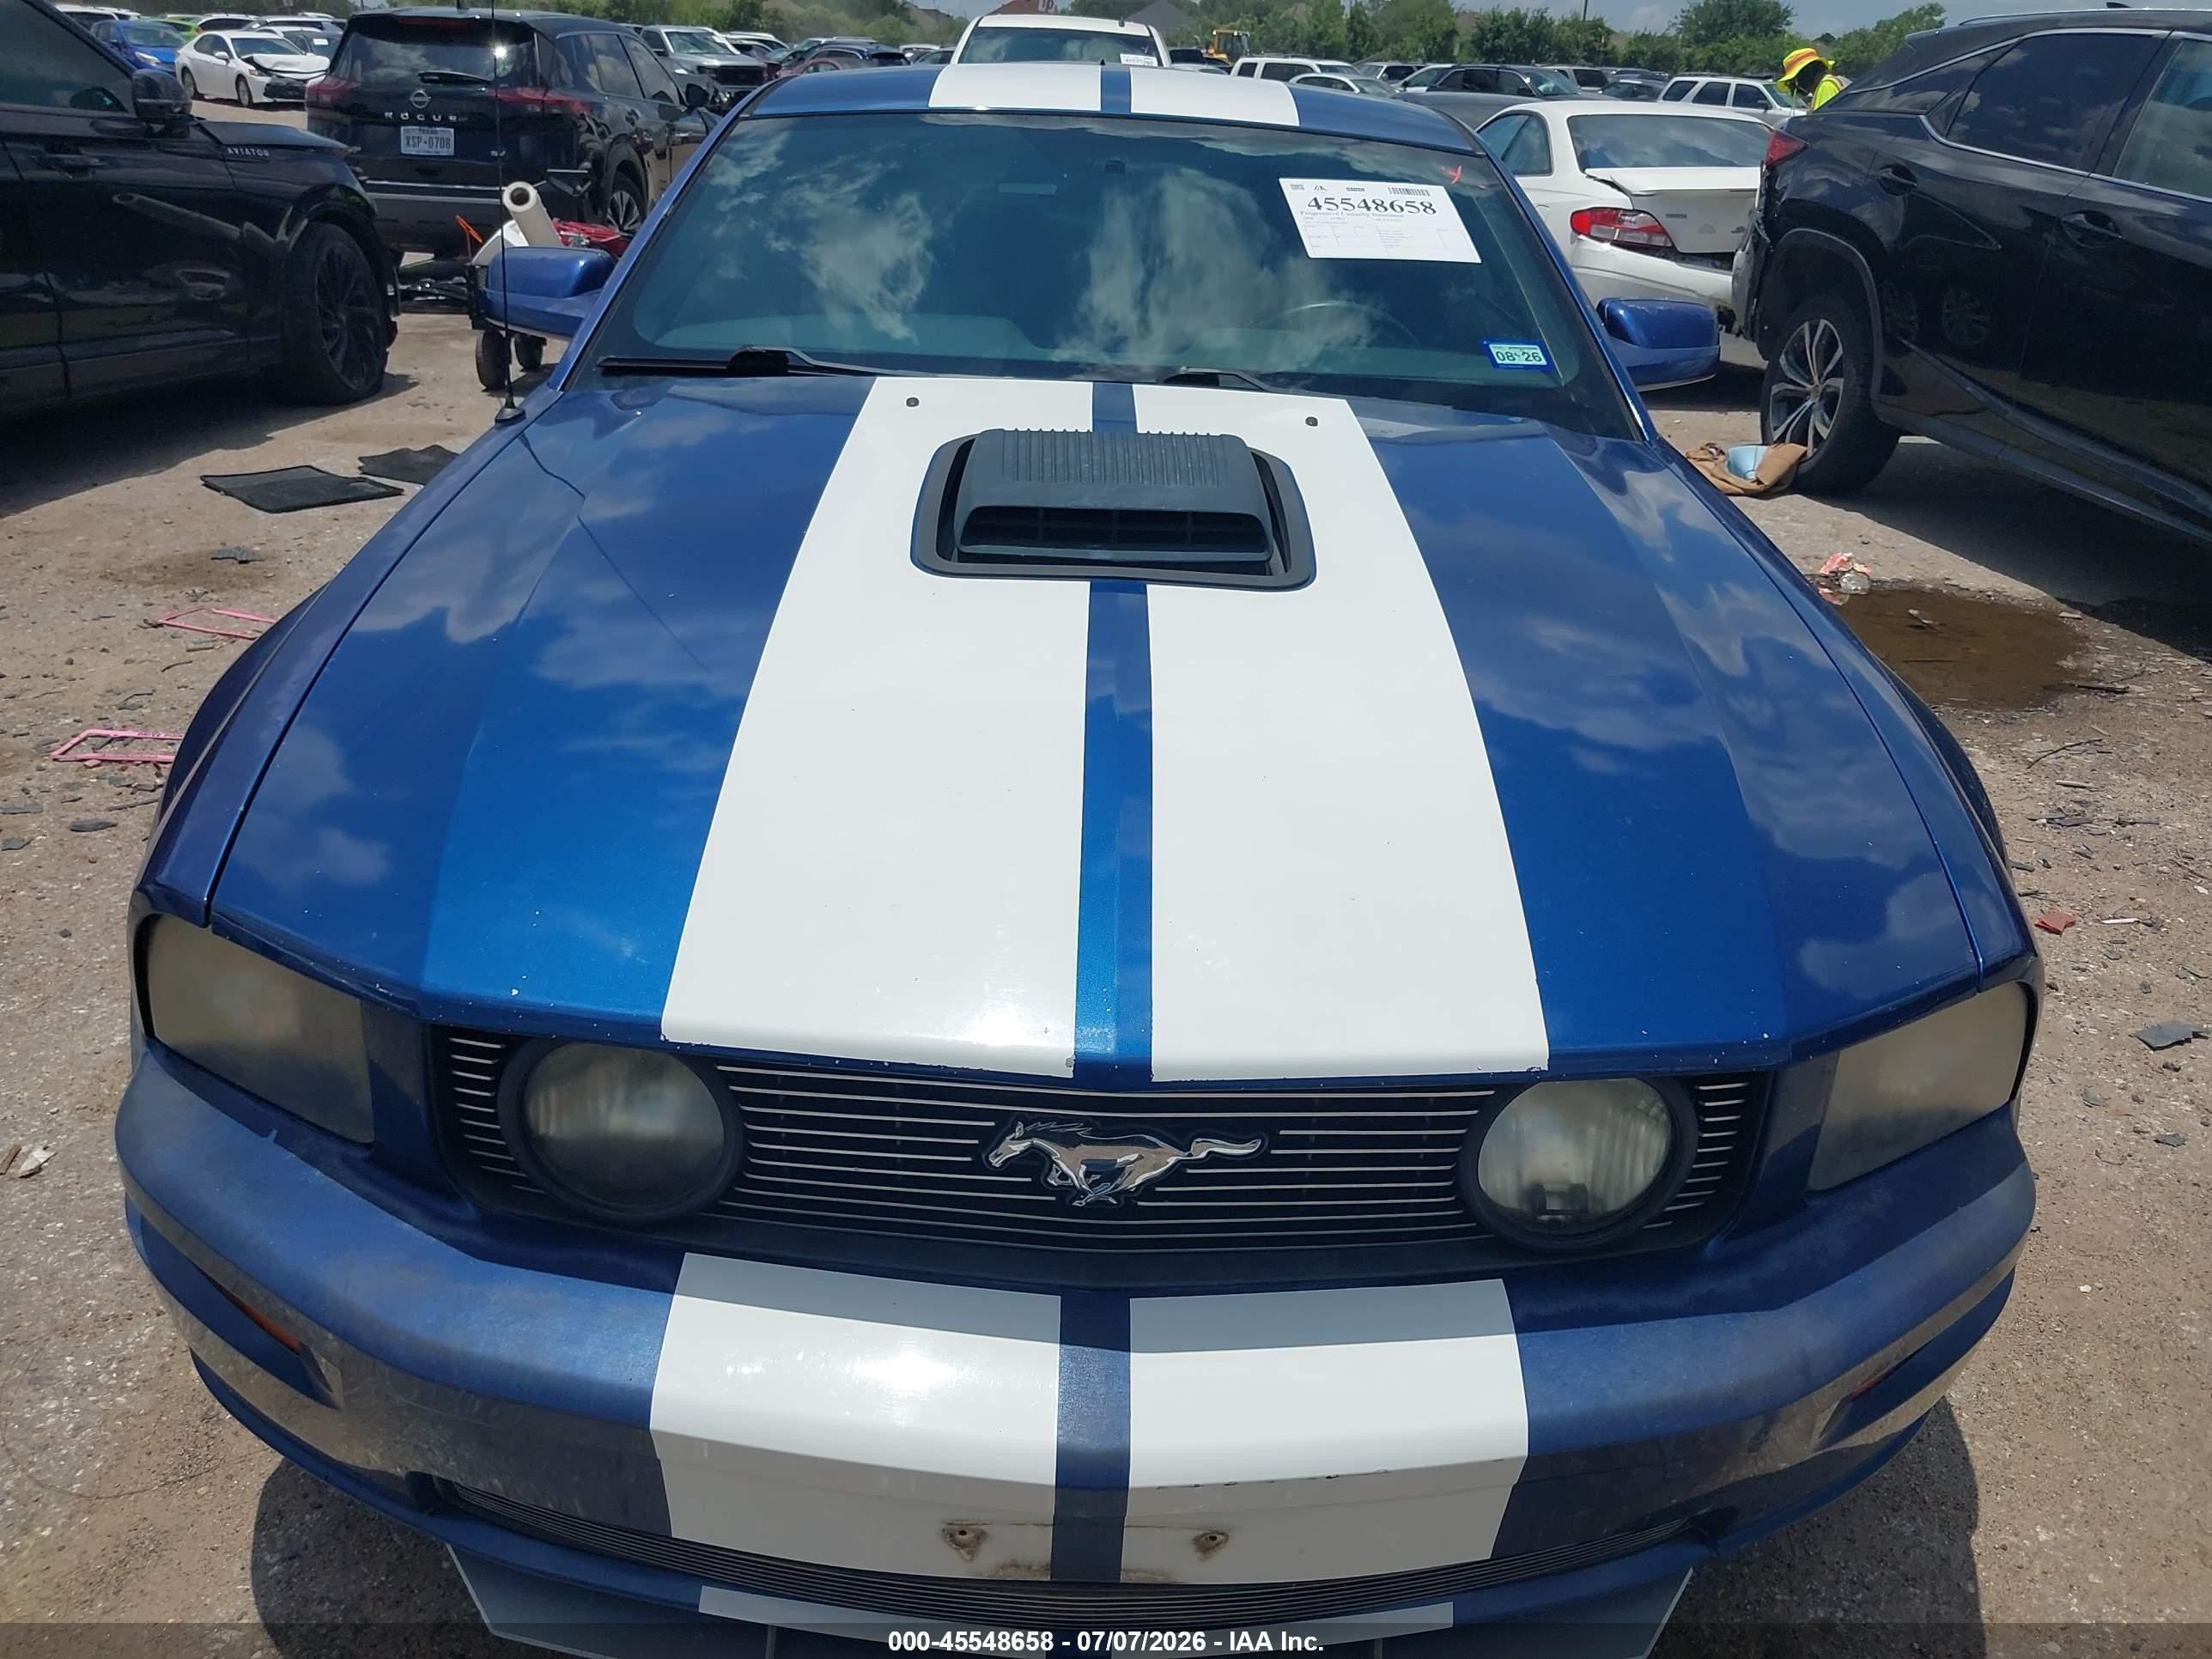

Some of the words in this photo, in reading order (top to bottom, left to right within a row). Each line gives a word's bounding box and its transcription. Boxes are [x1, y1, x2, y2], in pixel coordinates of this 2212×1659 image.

[384, 112, 458, 122] ROGUE
[227, 147, 270, 157] AVIATOR
[1308, 196, 1437, 215] 45548658
